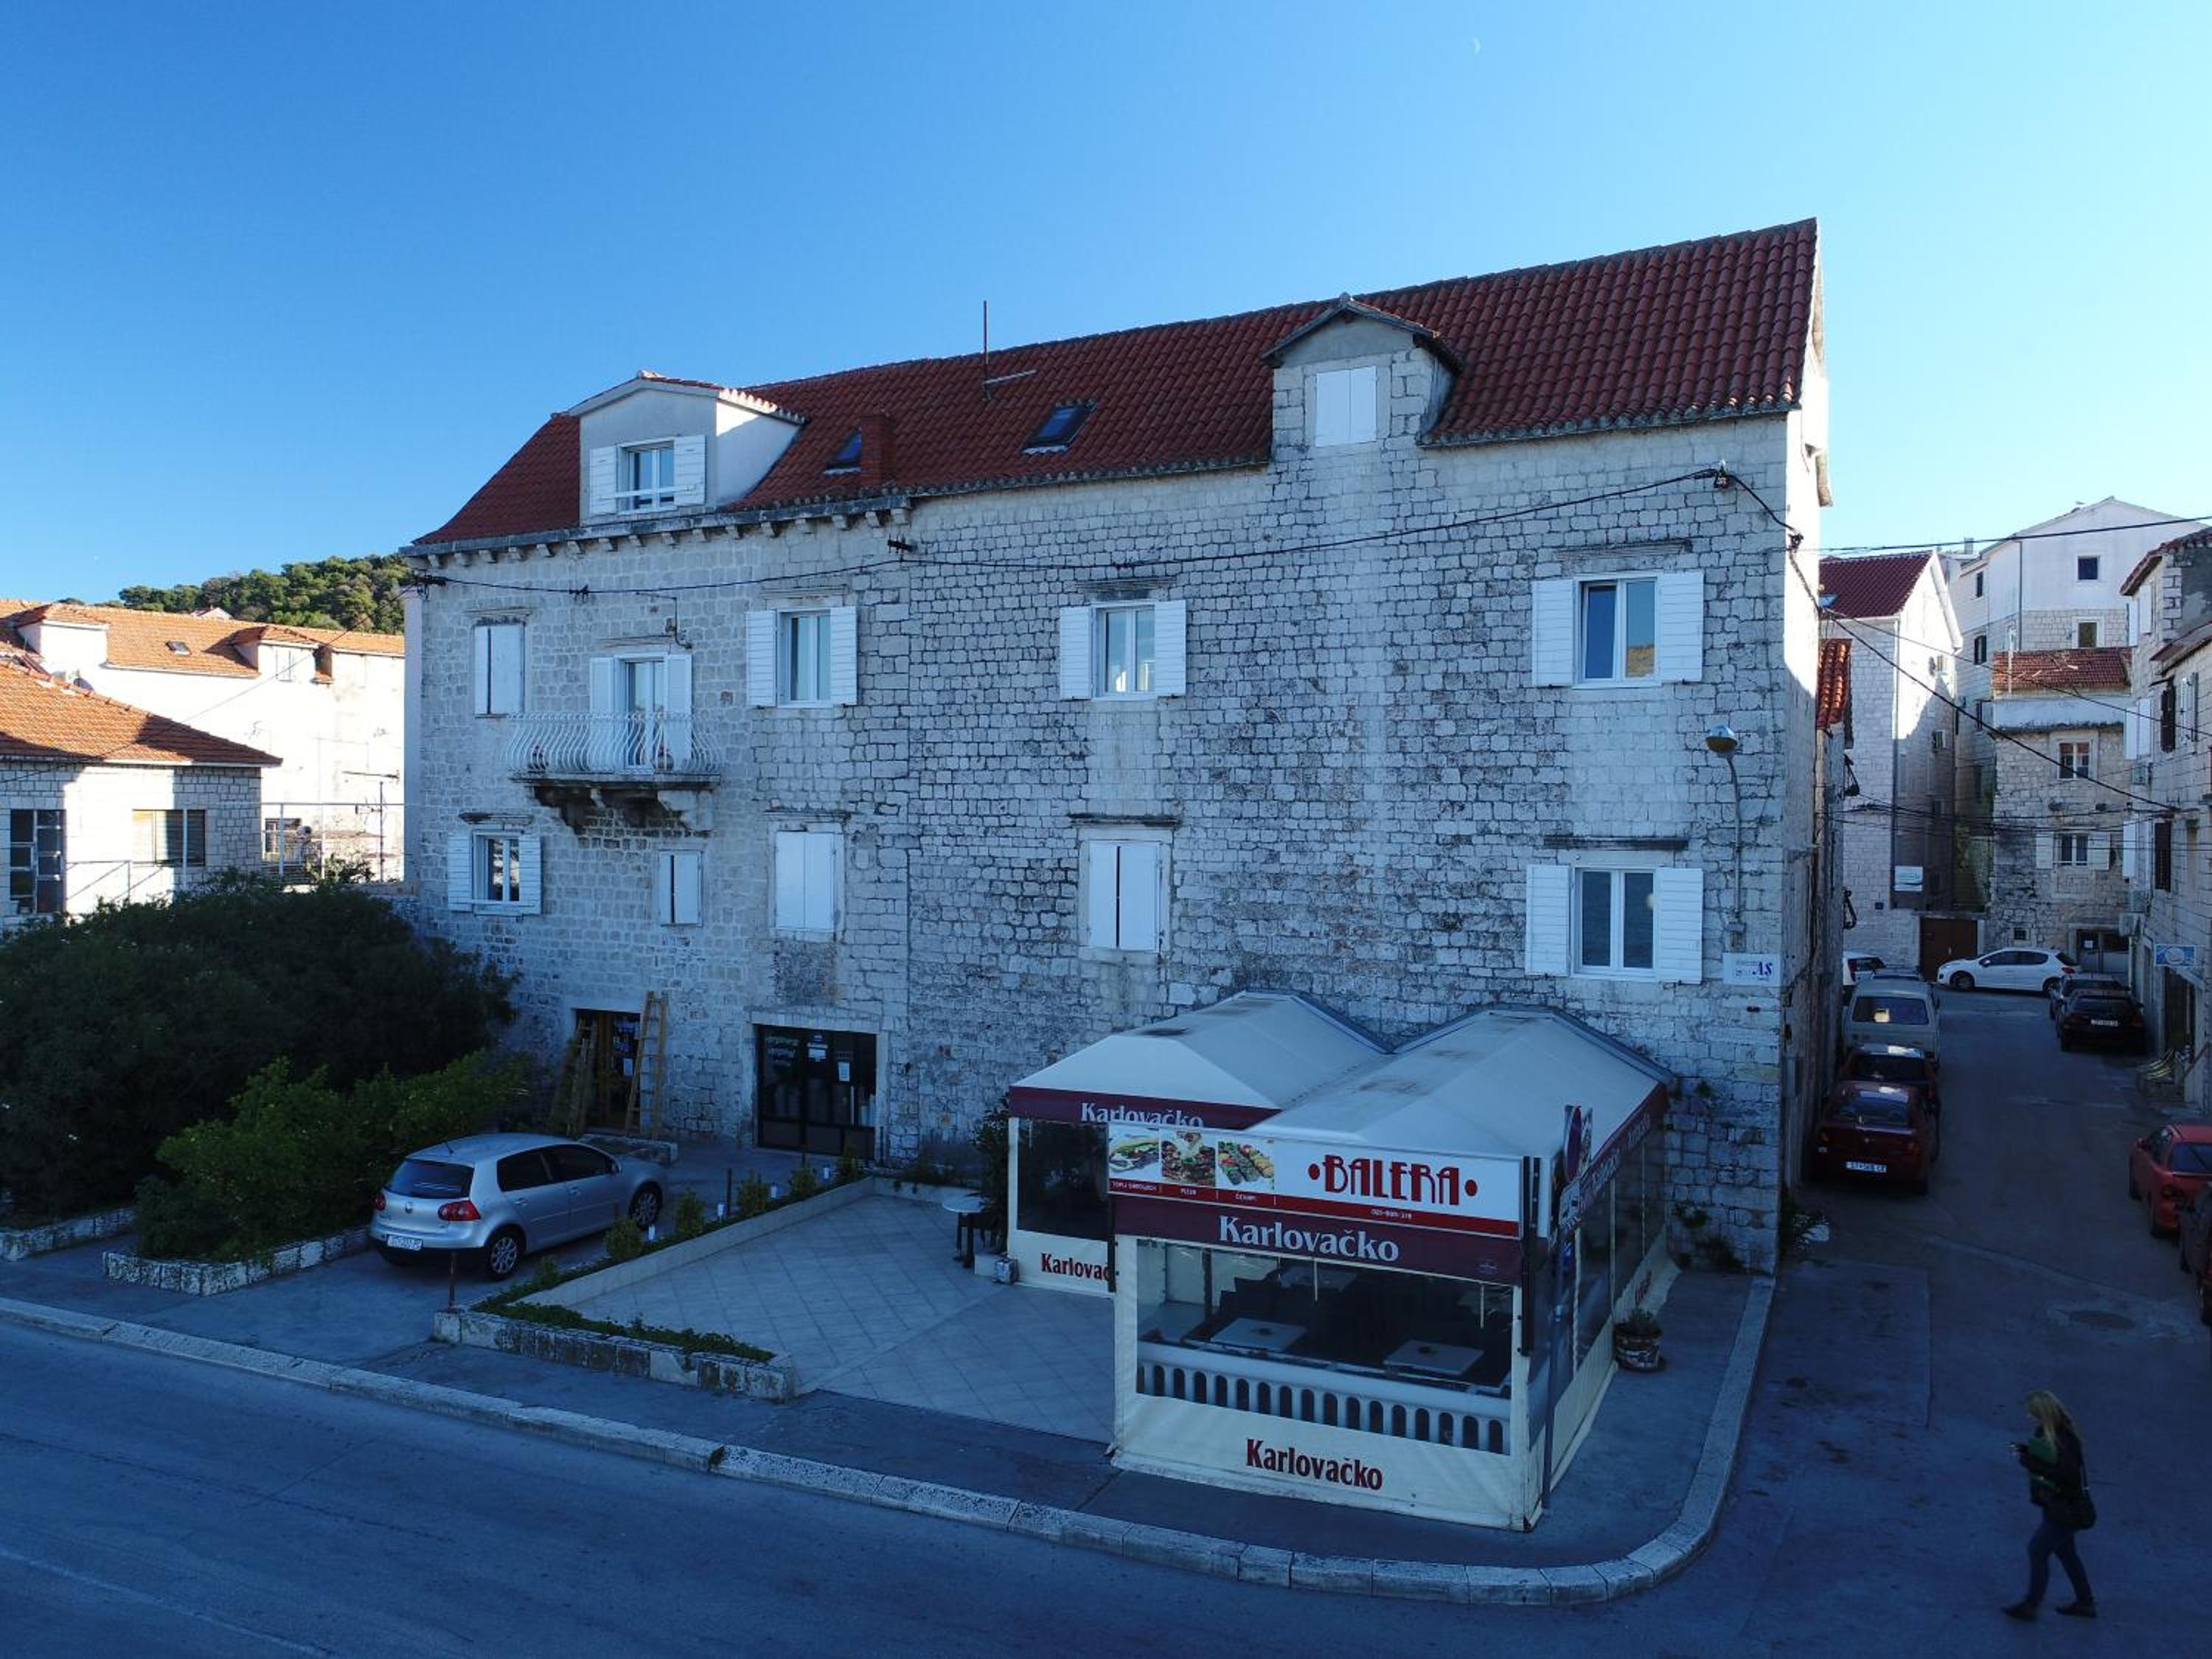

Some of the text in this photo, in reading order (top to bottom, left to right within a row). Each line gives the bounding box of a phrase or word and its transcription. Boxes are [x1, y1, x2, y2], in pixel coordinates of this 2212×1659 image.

[1080, 1102, 1204, 1128] Karlovačko
[1322, 1154, 1460, 1206] BALERA
[1219, 1215, 1399, 1262] Karlovačko
[1246, 1439, 1383, 1490] Karlovačko
